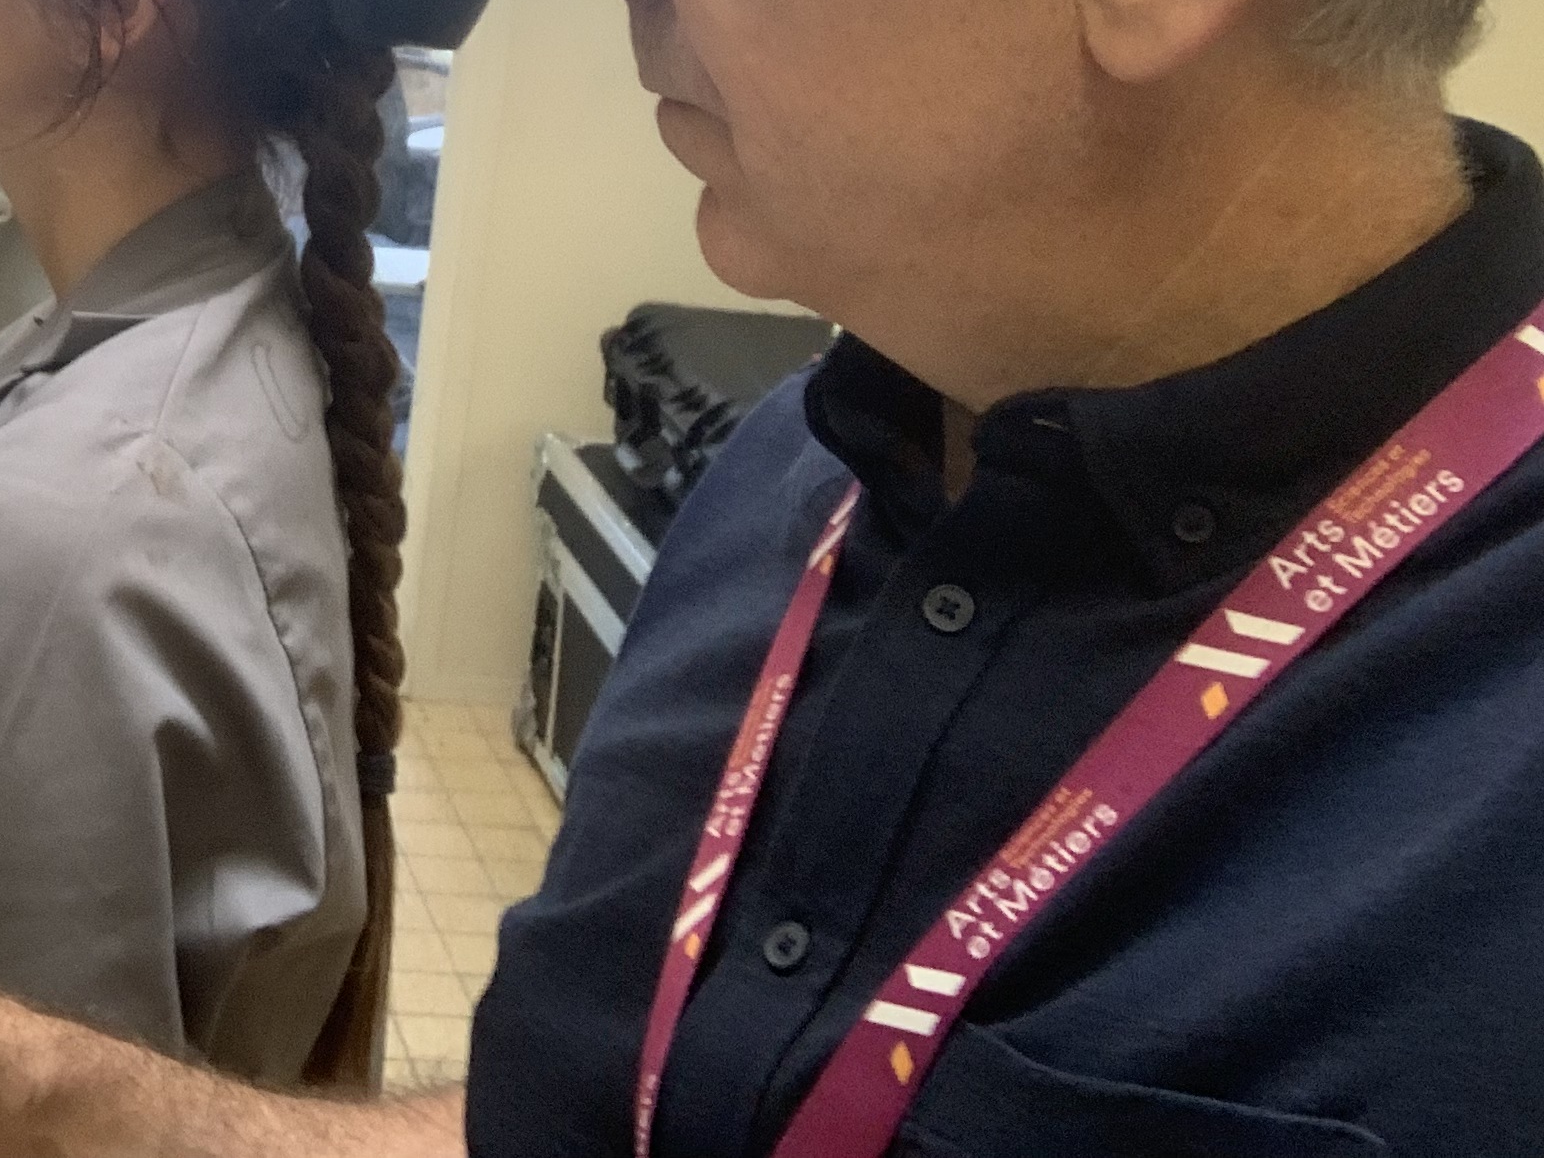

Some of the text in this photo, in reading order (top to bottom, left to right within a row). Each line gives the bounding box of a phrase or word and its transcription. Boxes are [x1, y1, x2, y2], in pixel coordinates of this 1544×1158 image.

[1267, 519, 1346, 590] Arts
[1303, 575, 1348, 613] et
[1334, 469, 1466, 579] Métiers
[944, 868, 1012, 940] Arts
[965, 920, 1004, 960] et
